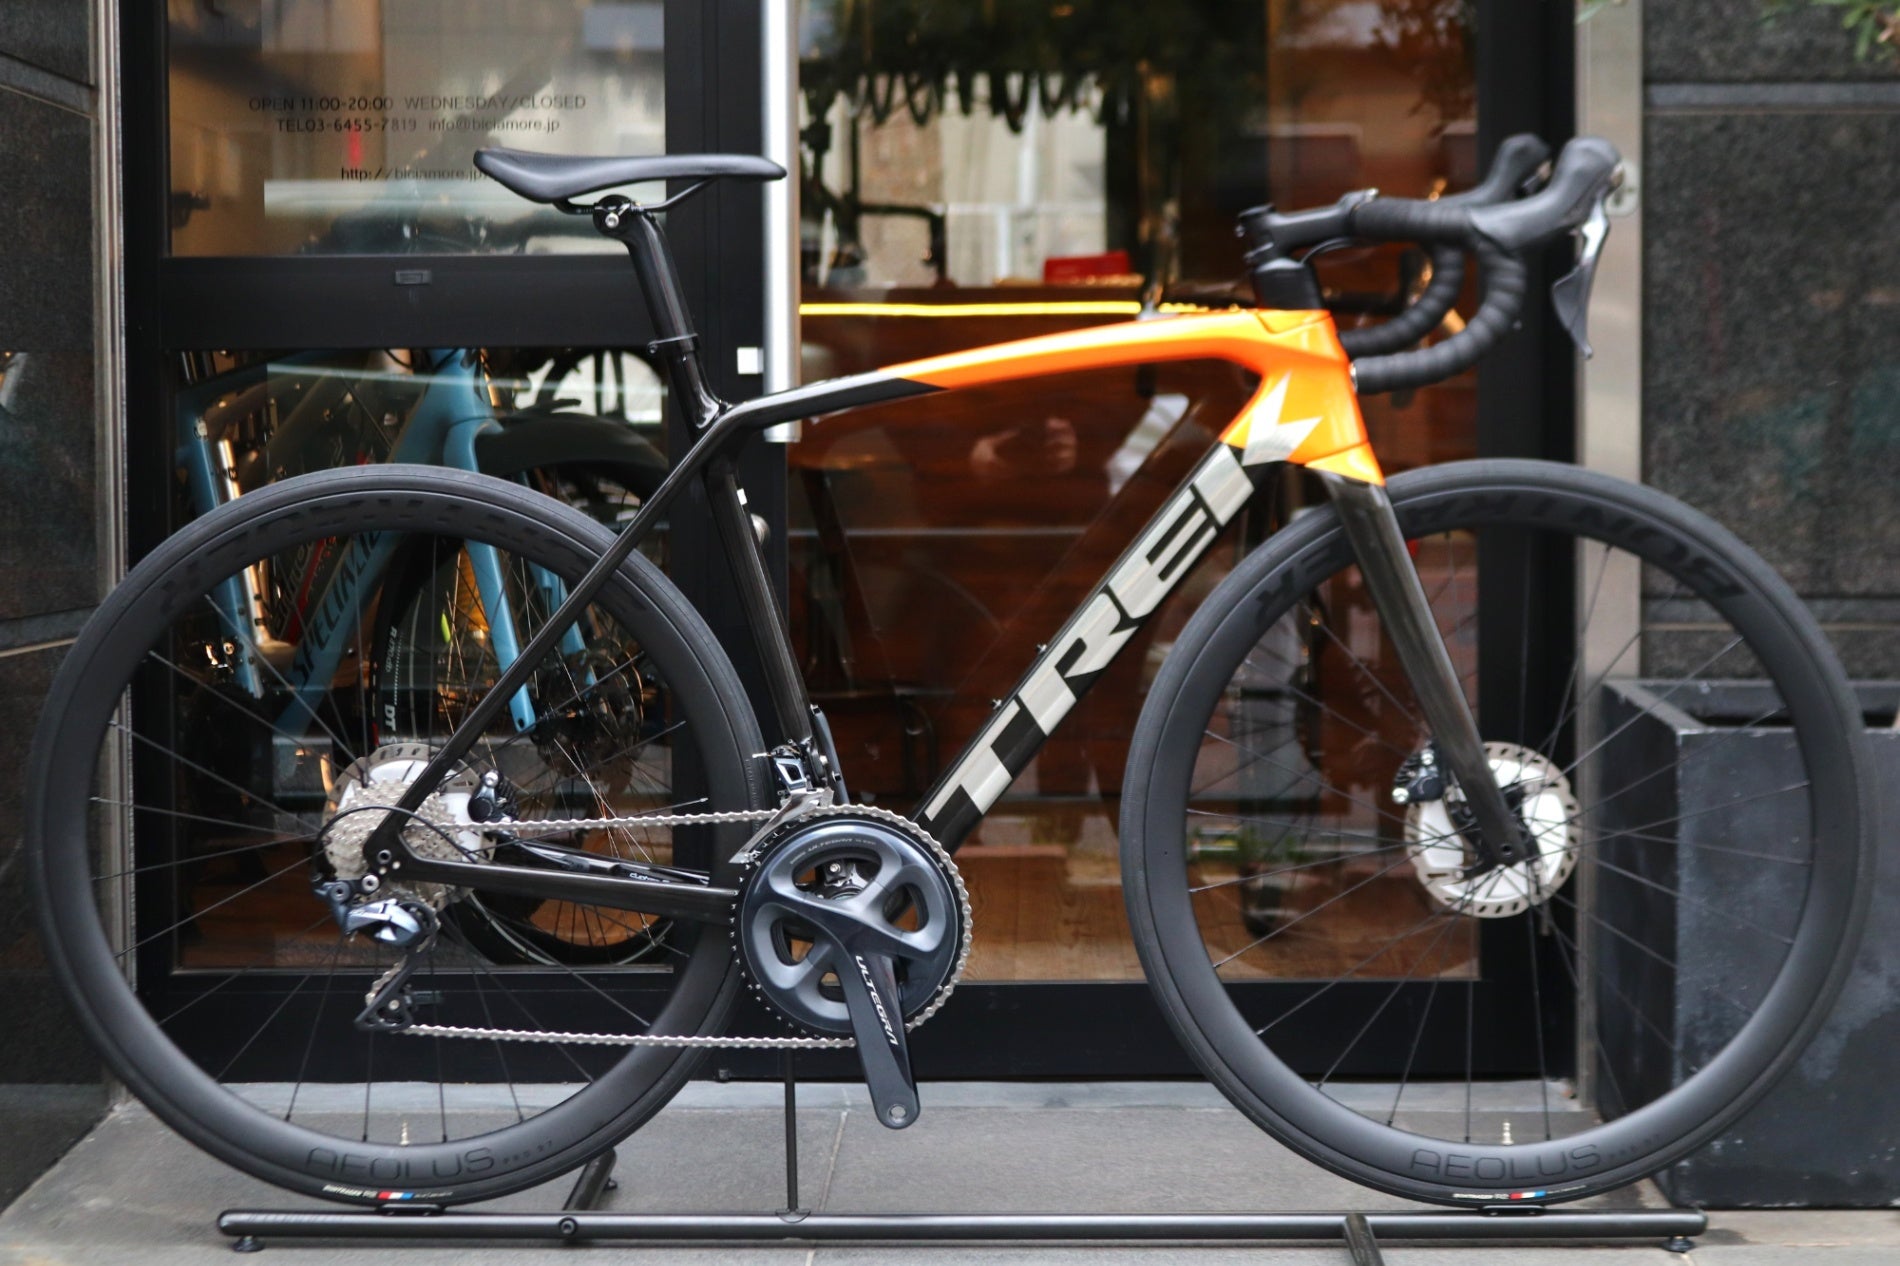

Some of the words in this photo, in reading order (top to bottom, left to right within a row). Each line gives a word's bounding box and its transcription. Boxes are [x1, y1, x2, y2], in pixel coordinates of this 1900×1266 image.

[249, 97, 295, 112] OPEN
[302, 96, 394, 112] 11:00-20:00
[405, 95, 586, 110] WEDNESDAY/CLOSED
[429, 118, 560, 135] info@biciamore.jp
[1256, 497, 1746, 624] BONTRAER
[923, 371, 1323, 822] TREK
[855, 954, 899, 1046] ULTEGRA
[305, 1146, 495, 1181] AEOLUS
[1409, 1143, 1601, 1181] AEOLUS
